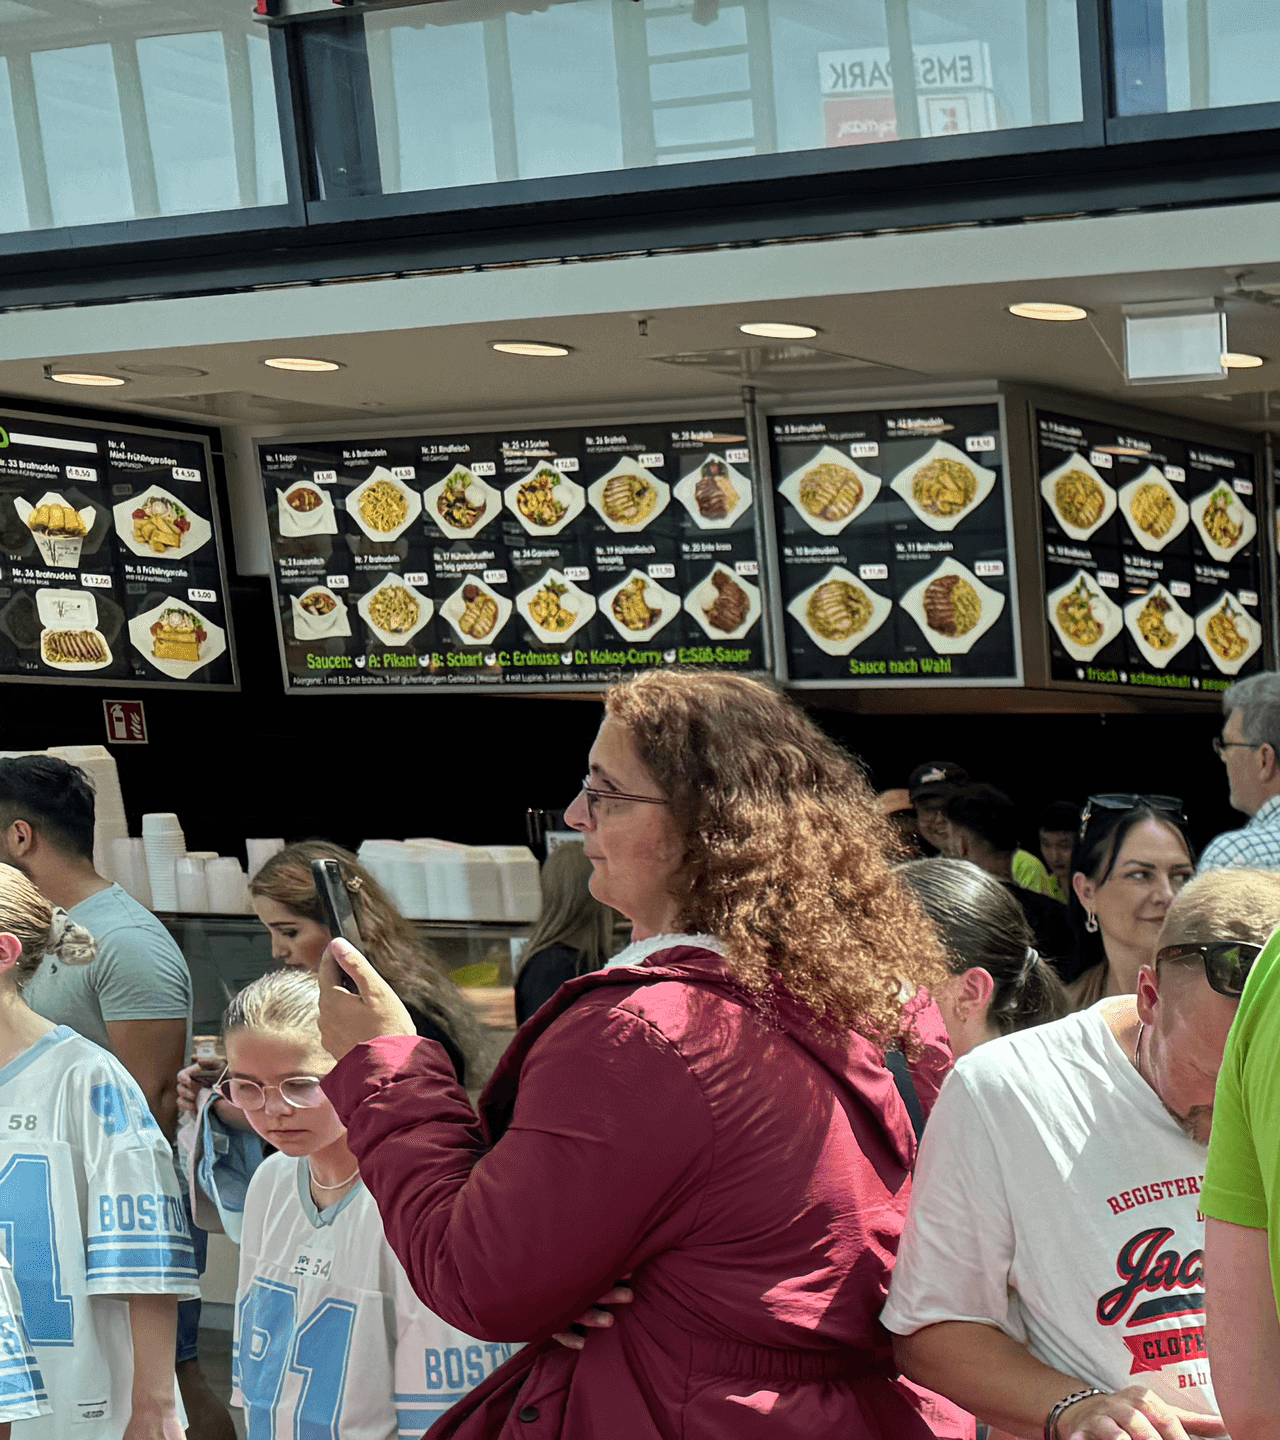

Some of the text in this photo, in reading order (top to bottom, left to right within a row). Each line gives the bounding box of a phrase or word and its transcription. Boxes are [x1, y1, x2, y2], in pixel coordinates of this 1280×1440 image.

[8, 460, 60, 473] 33 Bratnudeln
[12, 568, 76, 581] Nr. 36 Bratnudeln
[90, 577, 109, 586] 12,00
[306, 653, 352, 669] Saucen:
[368, 654, 381, 668] A:
[383, 653, 417, 668] Pikant
[432, 653, 444, 667] B:
[447, 652, 483, 667] Scharf
[498, 652, 511, 666] C:
[513, 651, 560, 666] Erdnuss
[575, 650, 588, 665] D:
[590, 650, 662, 666] Kokos-Curry
[850, 658, 951, 674] Sauce nach Wahl
[9, 1114, 37, 1131] 58
[1107, 1175, 1205, 1215] REGISTER
[425, 1343, 514, 1390] BOST
